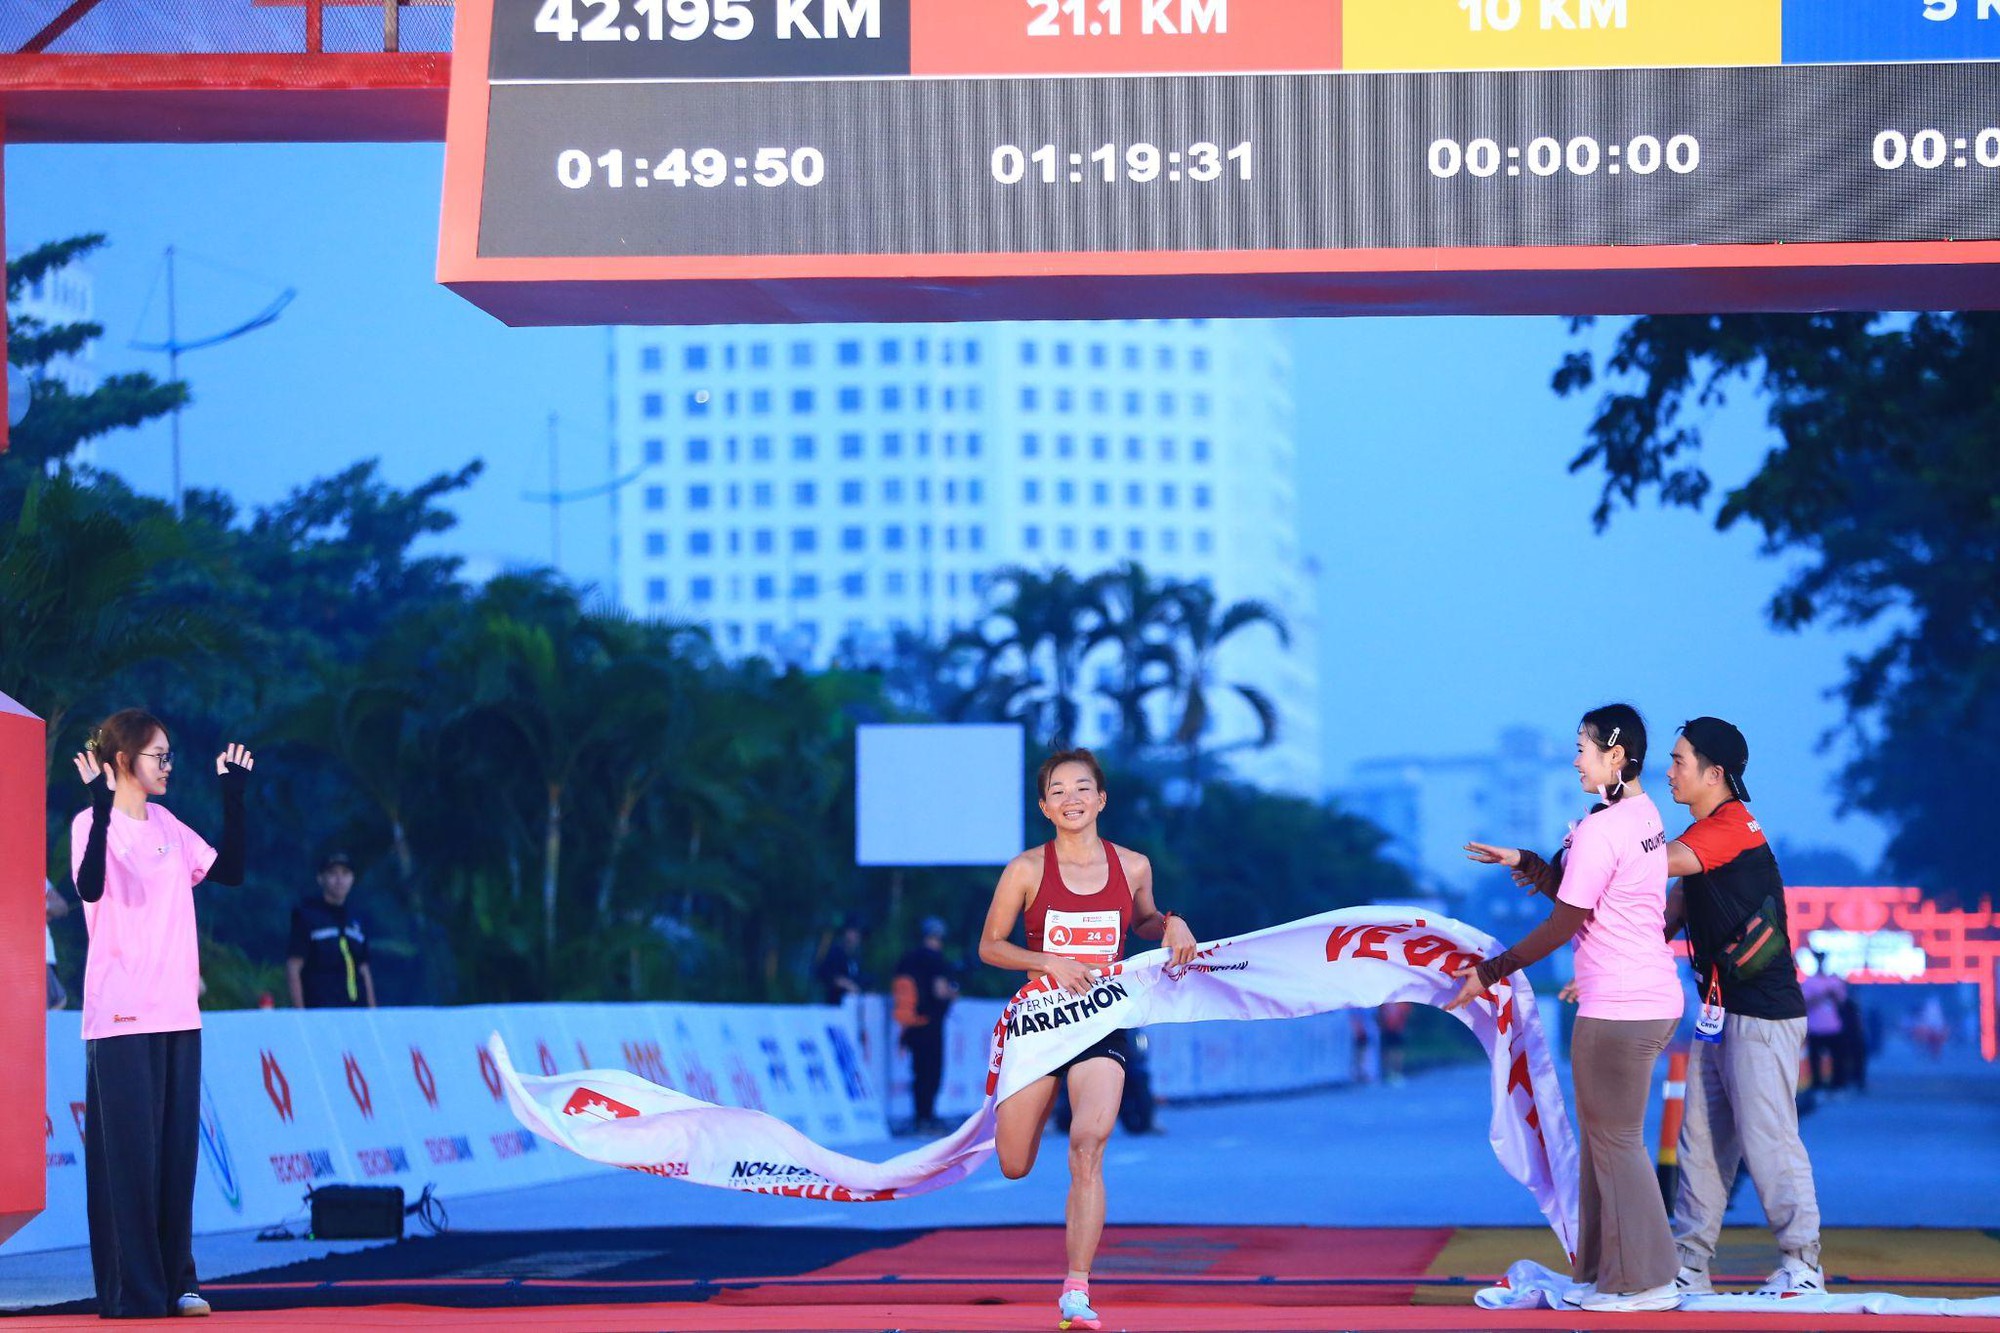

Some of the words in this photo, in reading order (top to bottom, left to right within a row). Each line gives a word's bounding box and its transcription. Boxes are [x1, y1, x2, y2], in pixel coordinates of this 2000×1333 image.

[535, 0, 755, 41] 42.195
[776, 0, 881, 39] KM
[1027, 0, 1121, 36] 21.1
[1142, 0, 1227, 34] KM
[1458, 0, 1521, 31] 10
[1540, 0, 1627, 30] KM
[557, 147, 825, 189] 01:49:50
[991, 142, 1253, 184] 01:19:31
[1428, 135, 1700, 178] 00:00:00
[1052, 929, 1066, 943] A
[1087, 932, 1101, 941] 24
[1006, 982, 1128, 1040] MARATHON
[1701, 1021, 1719, 1029] CREW
